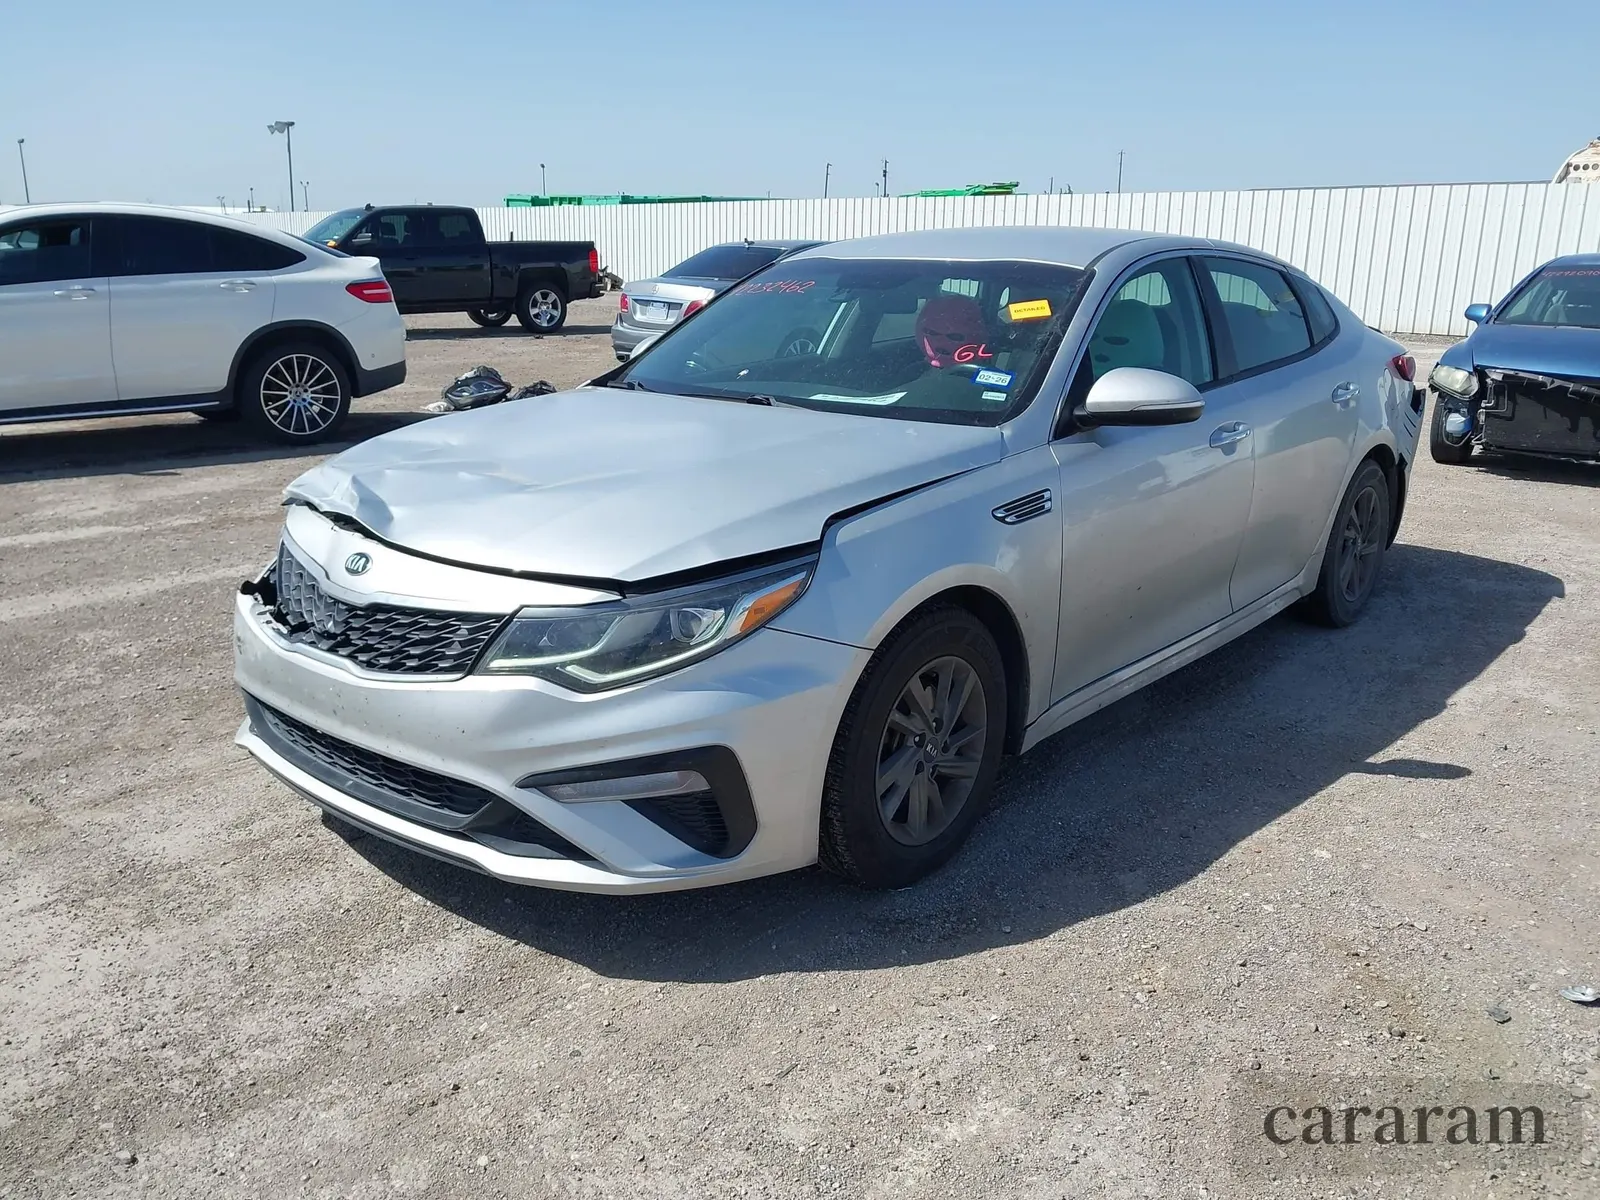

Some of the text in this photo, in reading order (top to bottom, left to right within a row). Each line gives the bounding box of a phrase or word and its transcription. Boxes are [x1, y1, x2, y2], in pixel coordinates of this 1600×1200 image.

[954, 344, 993, 362] GL
[345, 554, 367, 572] KIA
[926, 743, 938, 758] KIA
